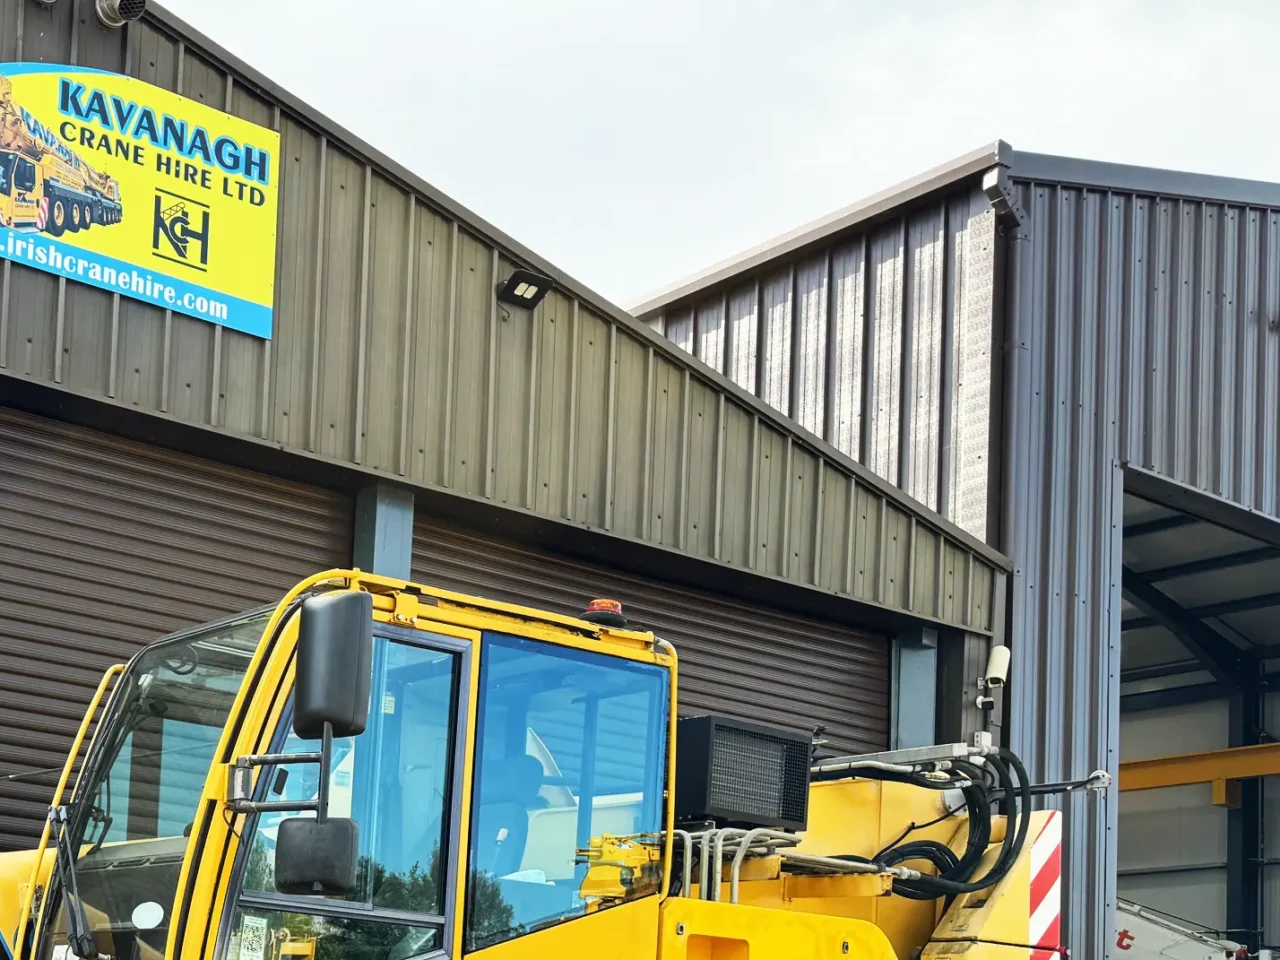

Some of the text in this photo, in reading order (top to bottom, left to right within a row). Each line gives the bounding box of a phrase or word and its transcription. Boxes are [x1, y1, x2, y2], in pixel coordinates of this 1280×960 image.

[57, 77, 270, 185] KAVANAGH
[59, 121, 145, 167] CRANE
[156, 154, 213, 190] HIRE
[222, 179, 266, 208] LTD
